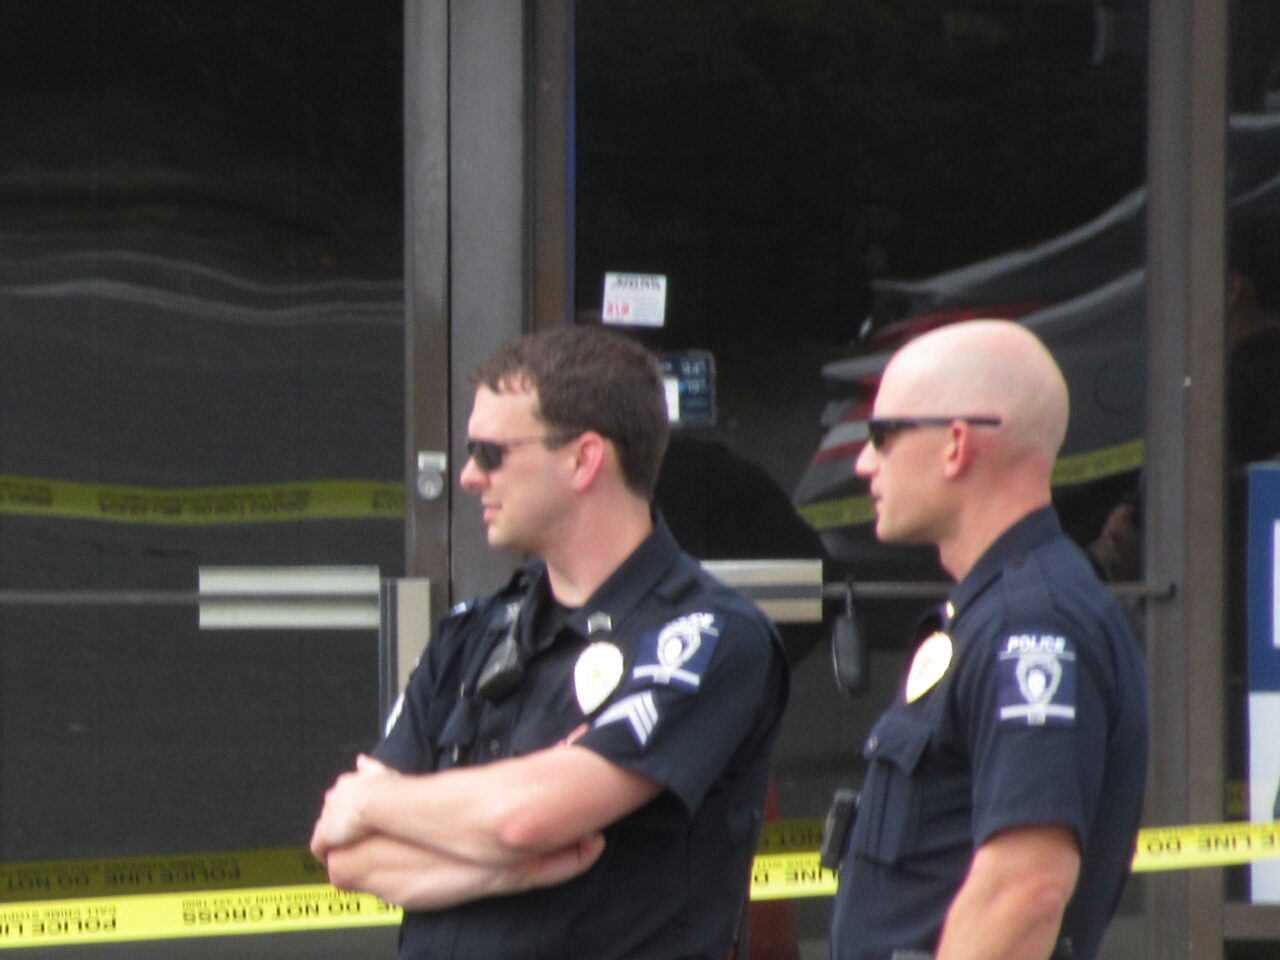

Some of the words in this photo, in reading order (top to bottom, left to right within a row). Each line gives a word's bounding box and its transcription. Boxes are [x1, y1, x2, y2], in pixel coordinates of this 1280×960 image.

[1146, 840, 1181, 856] DO
[1198, 836, 1251, 851] LINE
[182, 908, 264, 925] CROSS
[272, 904, 319, 920] NOT
[328, 902, 360, 917] DO
[32, 918, 116, 936] POLICE
